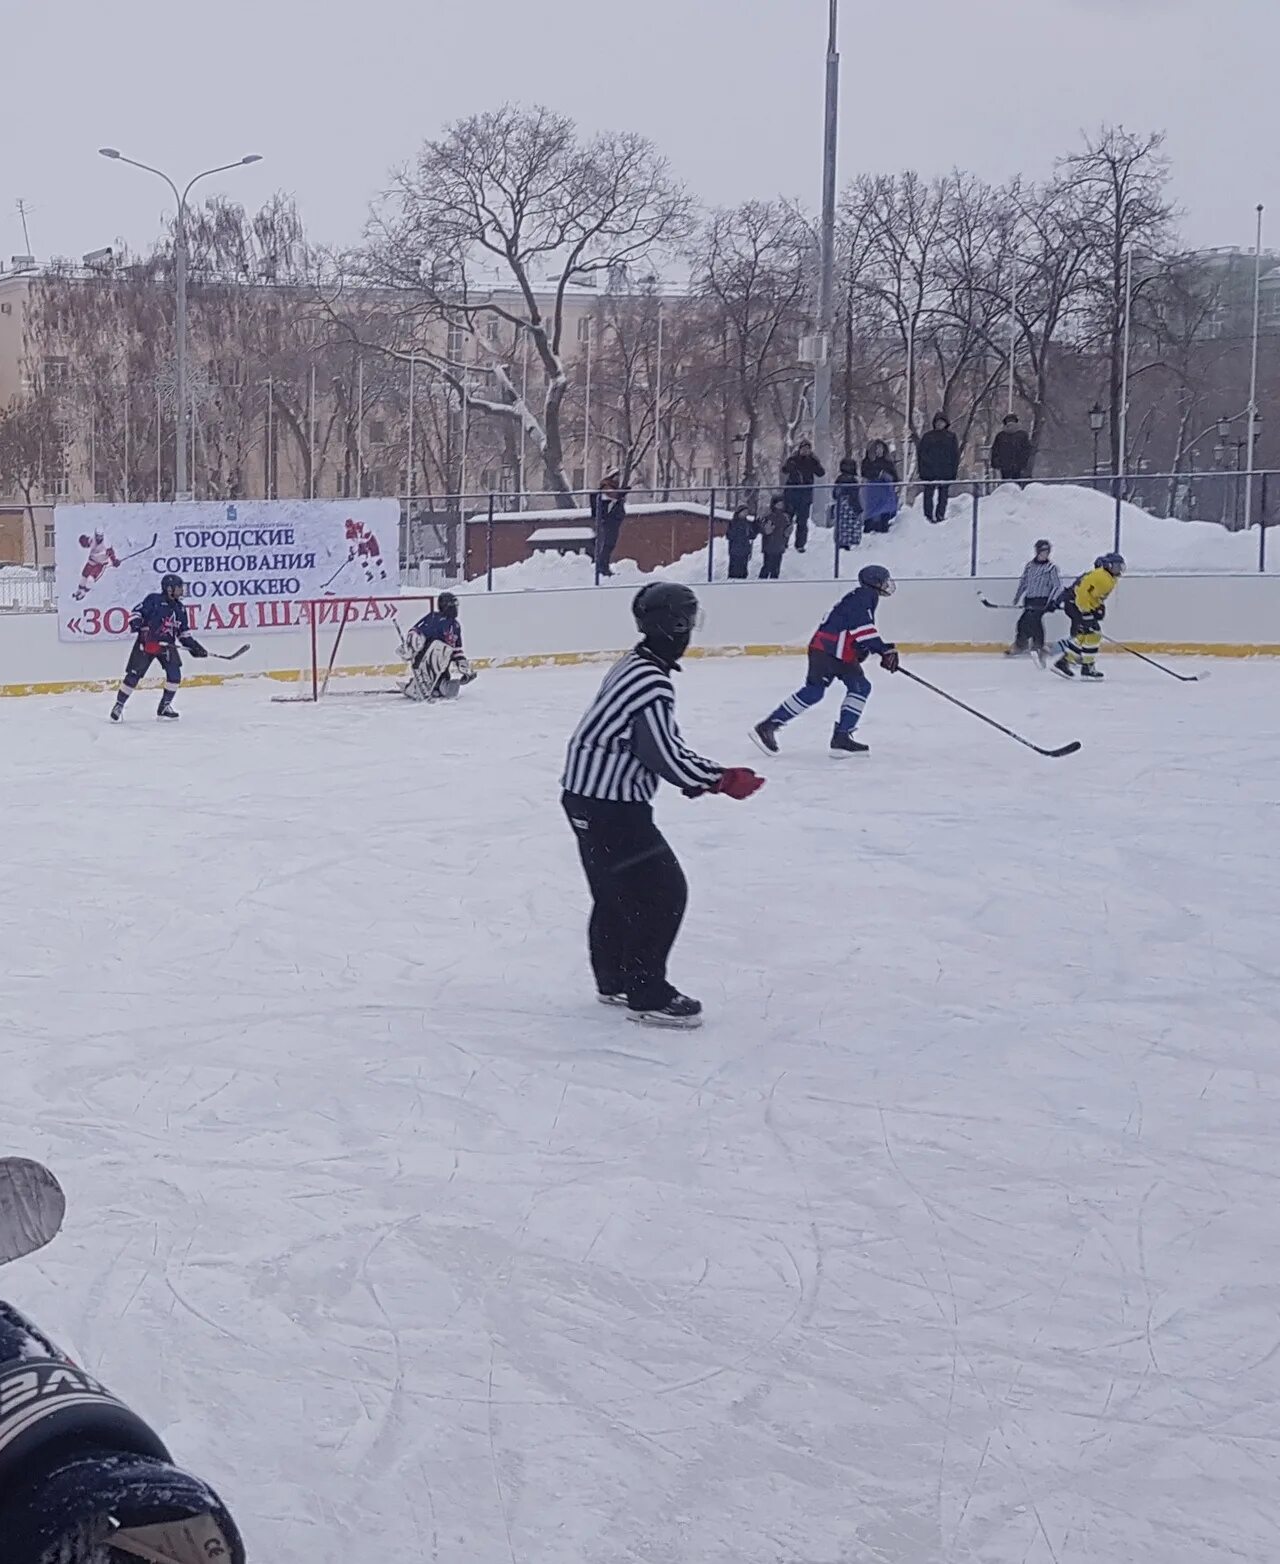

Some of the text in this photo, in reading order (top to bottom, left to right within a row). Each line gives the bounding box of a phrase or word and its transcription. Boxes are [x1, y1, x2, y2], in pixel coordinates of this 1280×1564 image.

[174, 529, 296, 550] ГОРОДСКИЕ
[152, 553, 316, 574] СОРЕВНОВАНИЯ
[211, 577, 301, 598] ХОККЕЮ
[66, 602, 248, 635] «ЗОТАЯ
